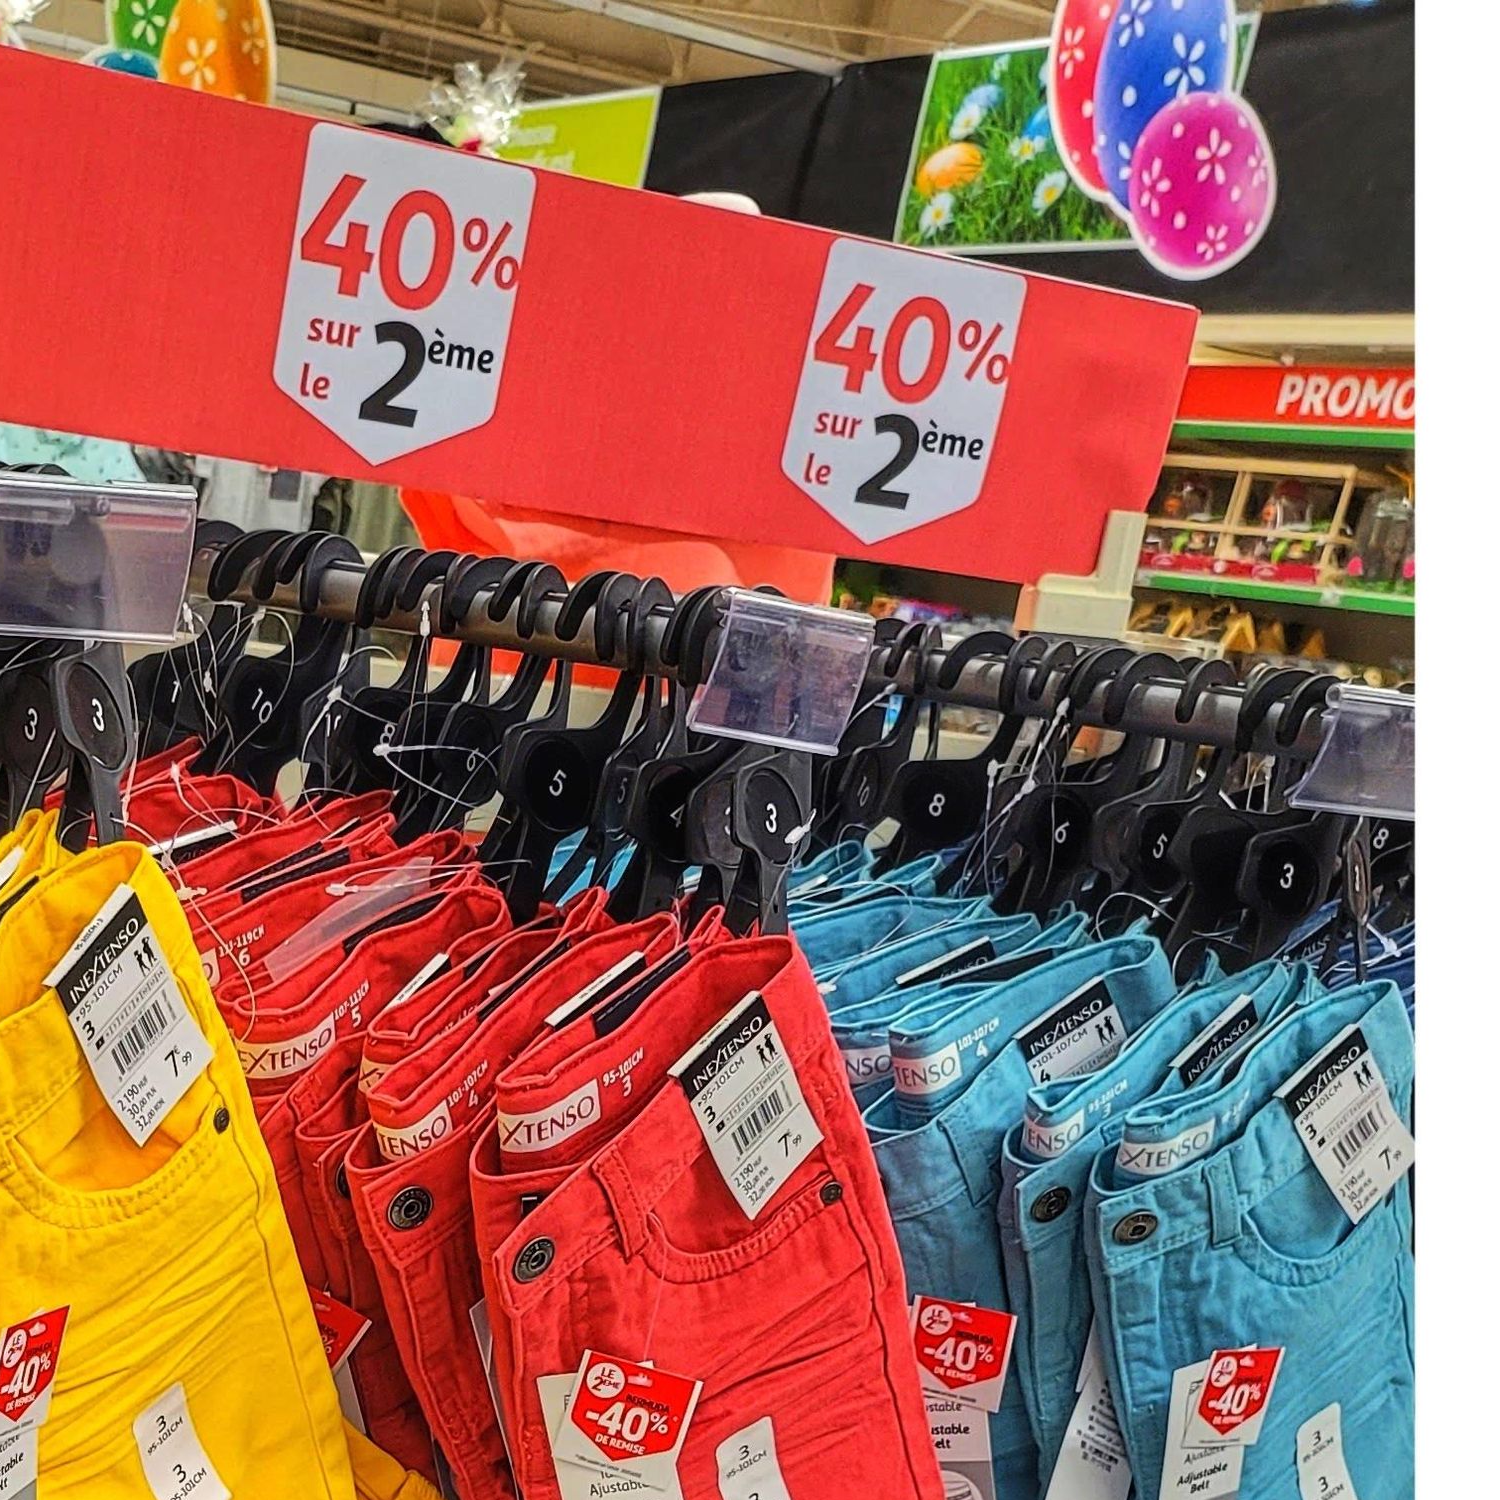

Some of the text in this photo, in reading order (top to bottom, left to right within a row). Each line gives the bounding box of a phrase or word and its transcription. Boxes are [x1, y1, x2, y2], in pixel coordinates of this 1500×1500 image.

[300, 173, 520, 311] 40%
[307, 316, 361, 349] sur
[813, 282, 1010, 404] 40%
[299, 362, 331, 401] le
[1275, 374, 1415, 420] PROMO
[814, 411, 862, 440] sur
[803, 452, 832, 486] le
[91, 698, 105, 732] 3
[251, 687, 273, 724] 10
[24, 707, 38, 741] 3
[379, 722, 396, 744] 8
[549, 769, 568, 797] 5
[670, 802, 687, 829] 4
[765, 802, 778, 833] 3
[928, 793, 947, 817] 8
[1054, 820, 1071, 844] 6
[1372, 827, 1390, 850] 8
[1153, 833, 1169, 859] 5
[1280, 862, 1295, 889] 3
[69, 917, 140, 1005] INEXTENSO
[238, 947, 251, 967] 6
[79, 963, 124, 1019] 95-101CM
[350, 1006, 362, 1028] 5
[1030, 999, 1103, 1056] INEXTENSO
[82, 1020, 96, 1042] 3
[692, 1015, 763, 1091] INEXTENSO
[975, 1039, 989, 1058] 4
[1188, 1016, 1250, 1082] INEXTENSO
[602, 1047, 645, 1088] 95-101CM
[701, 1055, 745, 1104] 95-101CM
[1295, 1045, 1361, 1112] INEXTENSO
[468, 1090, 479, 1109] 4
[622, 1077, 632, 1098] 3
[703, 1105, 716, 1125] 3
[1305, 1124, 1317, 1141] 3
[923, 1336, 995, 1373] -40%
[0, 1351, 52, 1398] -40%
[601, 1366, 616, 1380] LE
[1207, 1383, 1262, 1417] -40%
[156, 1415, 168, 1434] 3
[585, 1401, 669, 1443] -40%
[594, 1433, 646, 1456] DE REMISE
[1312, 1430, 1322, 1447] 3
[738, 1444, 750, 1461] 3
[172, 1463, 188, 1484] 3
[1177, 1461, 1228, 1488] Adjustable
[1318, 1475, 1329, 1493] 3
[1190, 1480, 1210, 1495] Belt
